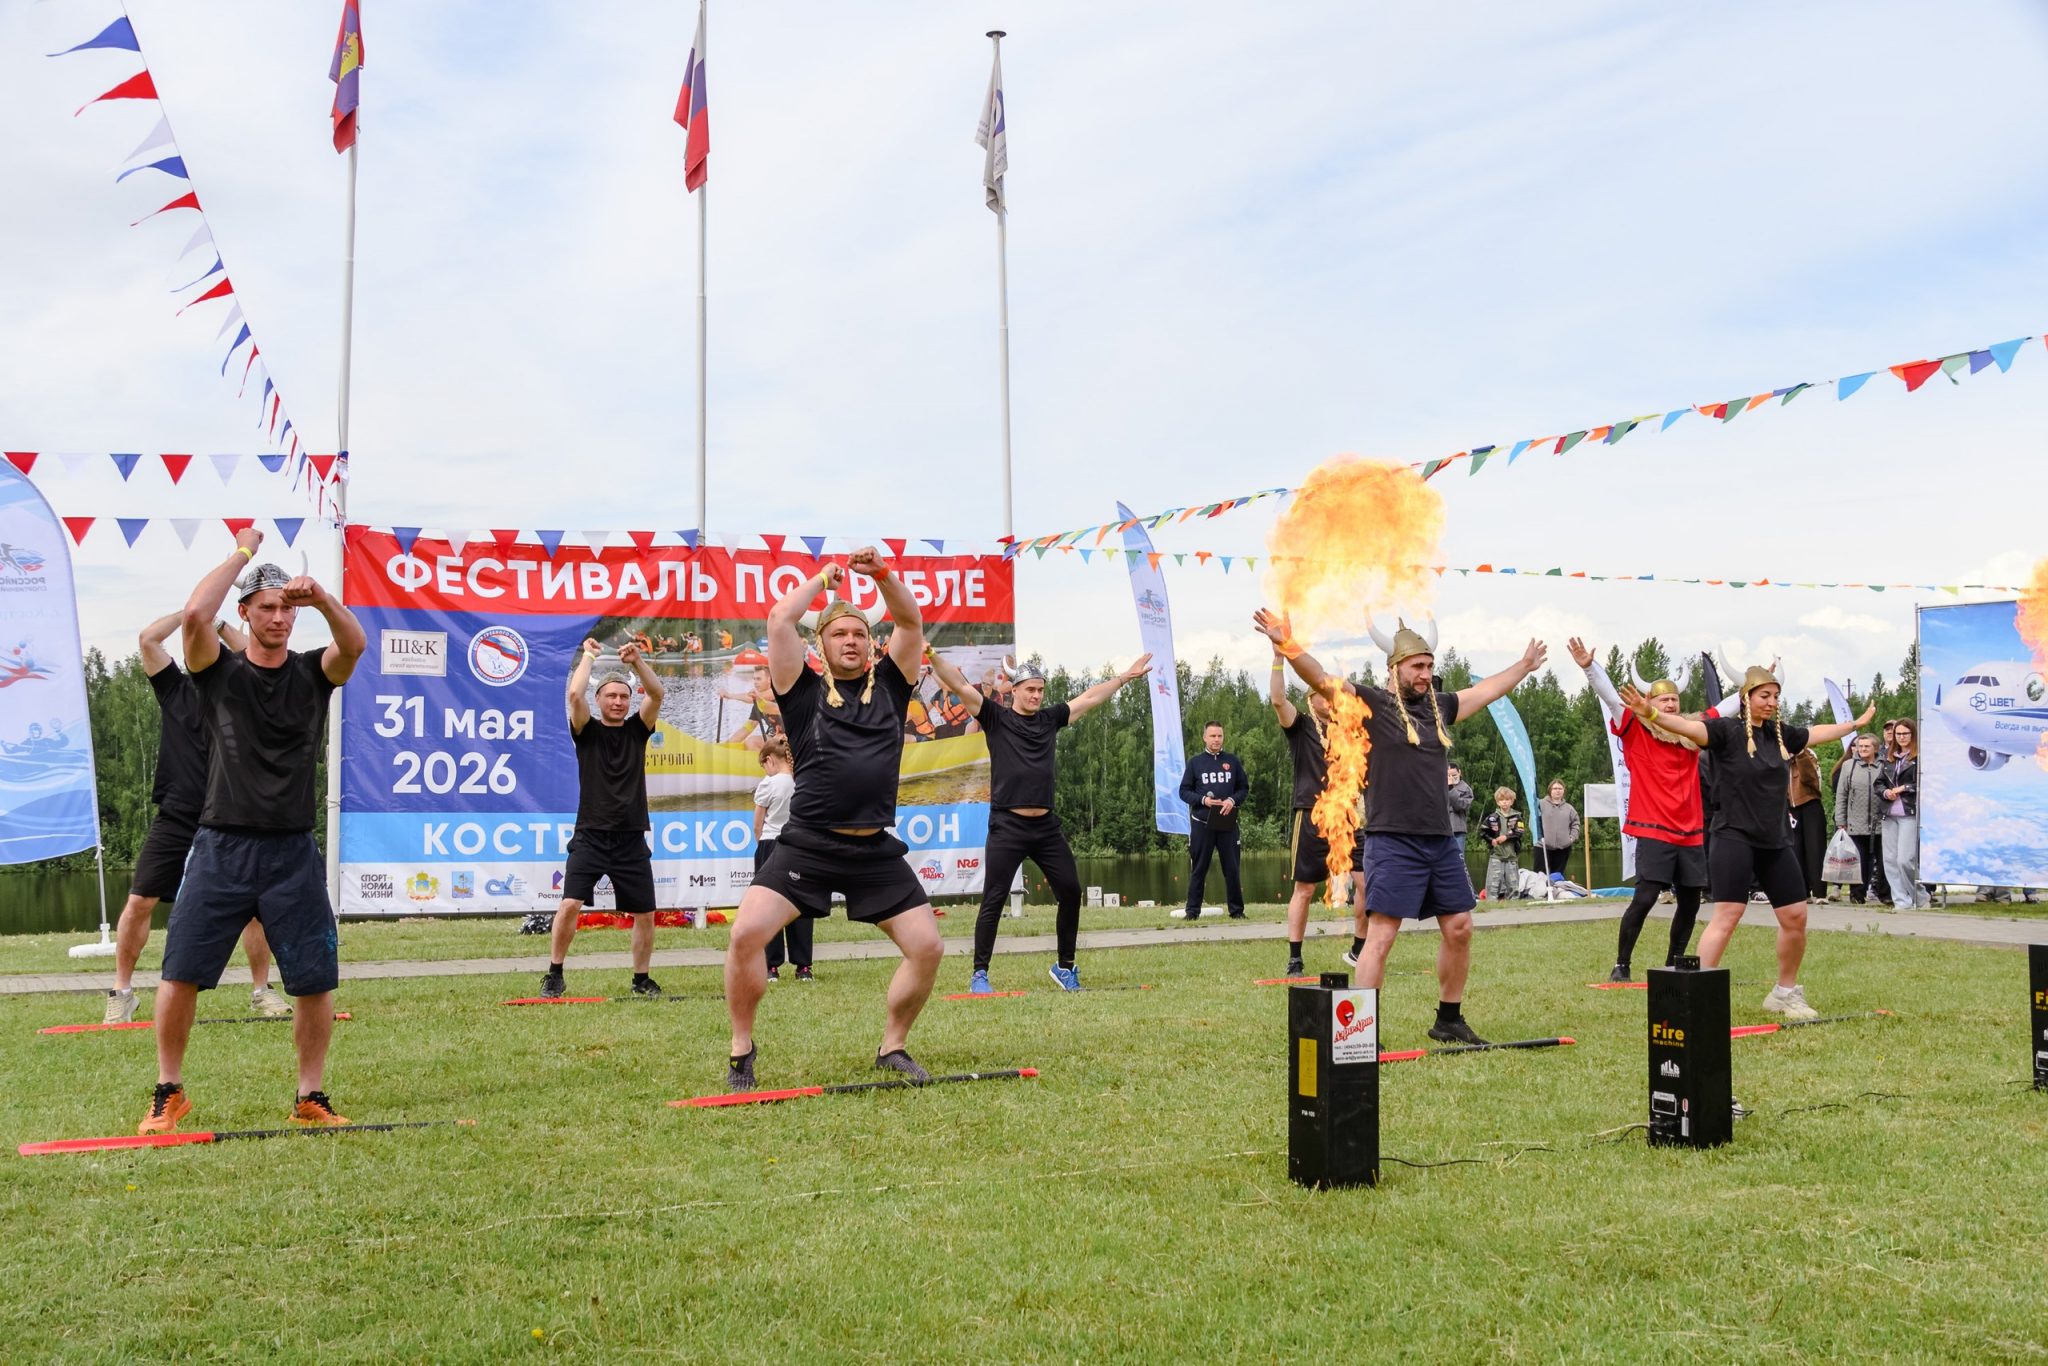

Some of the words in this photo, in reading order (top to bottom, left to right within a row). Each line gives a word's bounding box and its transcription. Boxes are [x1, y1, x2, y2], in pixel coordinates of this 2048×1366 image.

[386, 551, 718, 602] ФЕСТИВАЛЬ
[736, 563, 808, 604] ПО
[826, 569, 986, 608] РБЛЕ
[391, 639, 438, 656] Ш&К
[1989, 697, 2015, 708] ЦВЕТ
[374, 695, 424, 738] 31
[444, 708, 534, 740] мая
[392, 751, 517, 795] 2026
[1201, 771, 1232, 784] СССР
[423, 820, 752, 856] КОСТРСКО
[957, 859, 979, 869] NRG
[360, 874, 387, 882] СПОРТ
[361, 882, 393, 890] НОРМА
[361, 890, 393, 898] ЖИЗНИ
[1111, 897, 1117, 905] 6
[1653, 1021, 1684, 1041] Fire
[1653, 1040, 1684, 1048] machine
